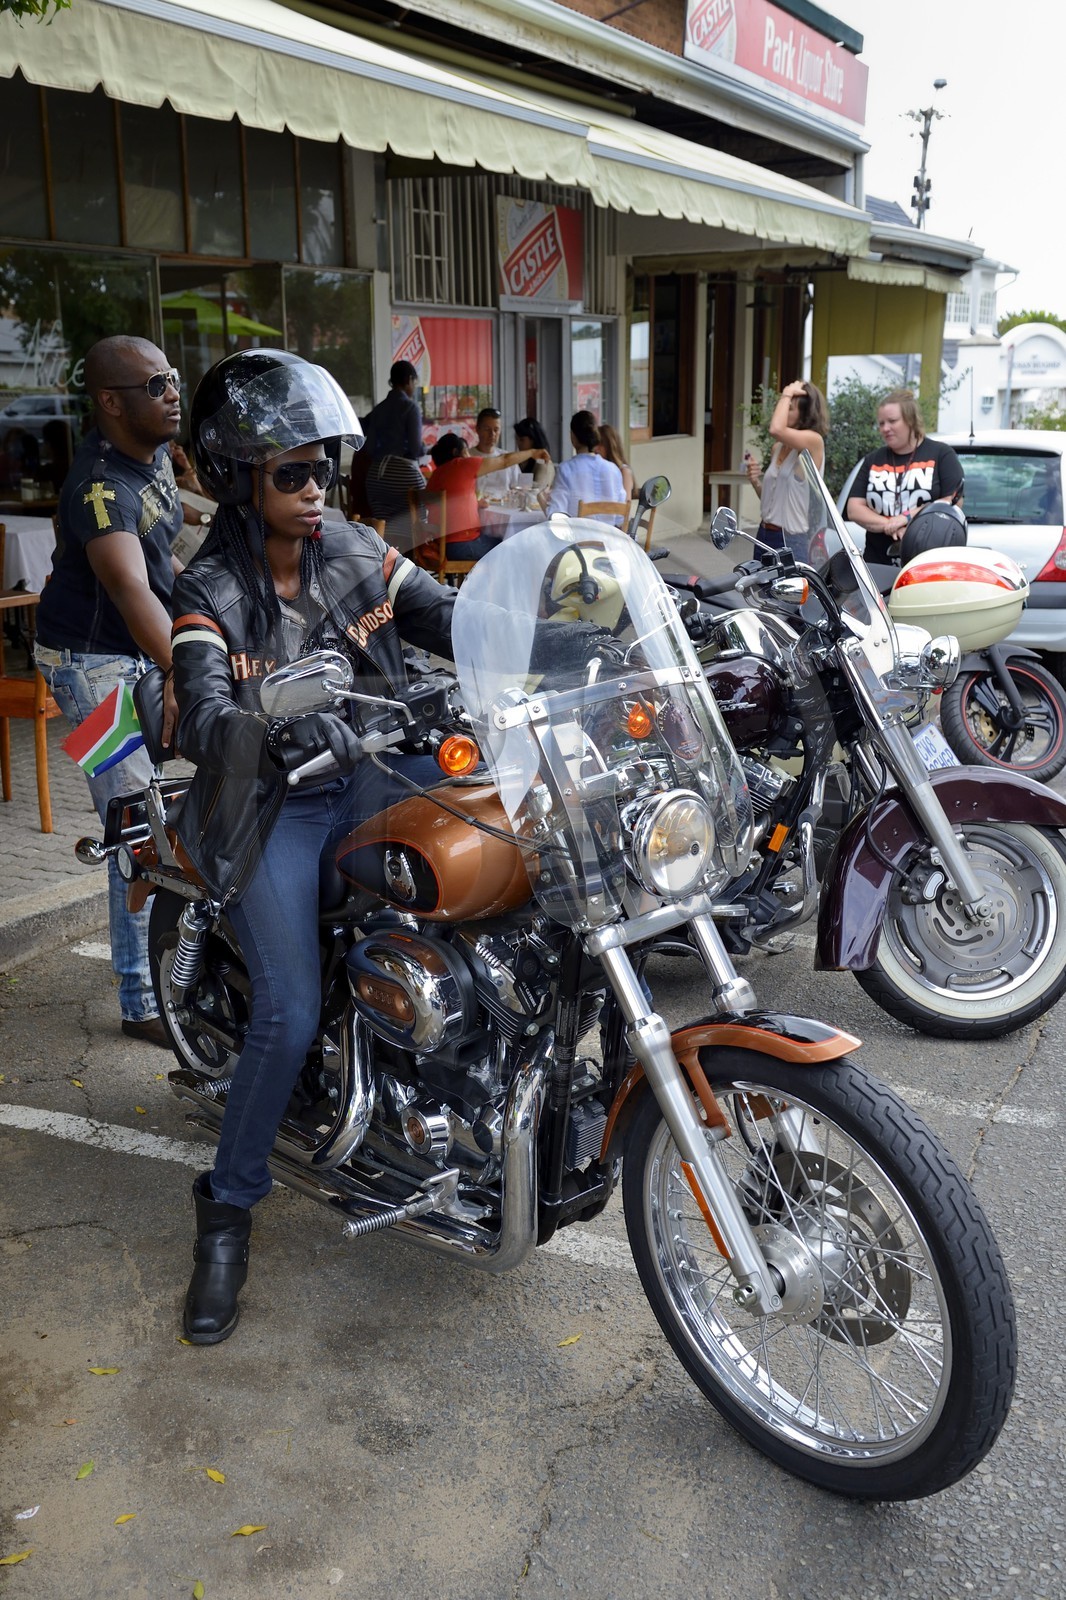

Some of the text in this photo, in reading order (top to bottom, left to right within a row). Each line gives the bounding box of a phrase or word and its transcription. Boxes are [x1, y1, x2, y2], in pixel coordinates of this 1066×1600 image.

[763, 16, 795, 80] Park
[797, 33, 824, 96] Liquor
[822, 48, 845, 104] Store
[510, 227, 557, 293] CASTLE
[400, 333, 422, 361] STLE
[869, 466, 934, 493] RUN
[866, 488, 932, 518] DMC
[347, 600, 394, 648] DAVIDSO
[915, 735, 937, 762] CW8
